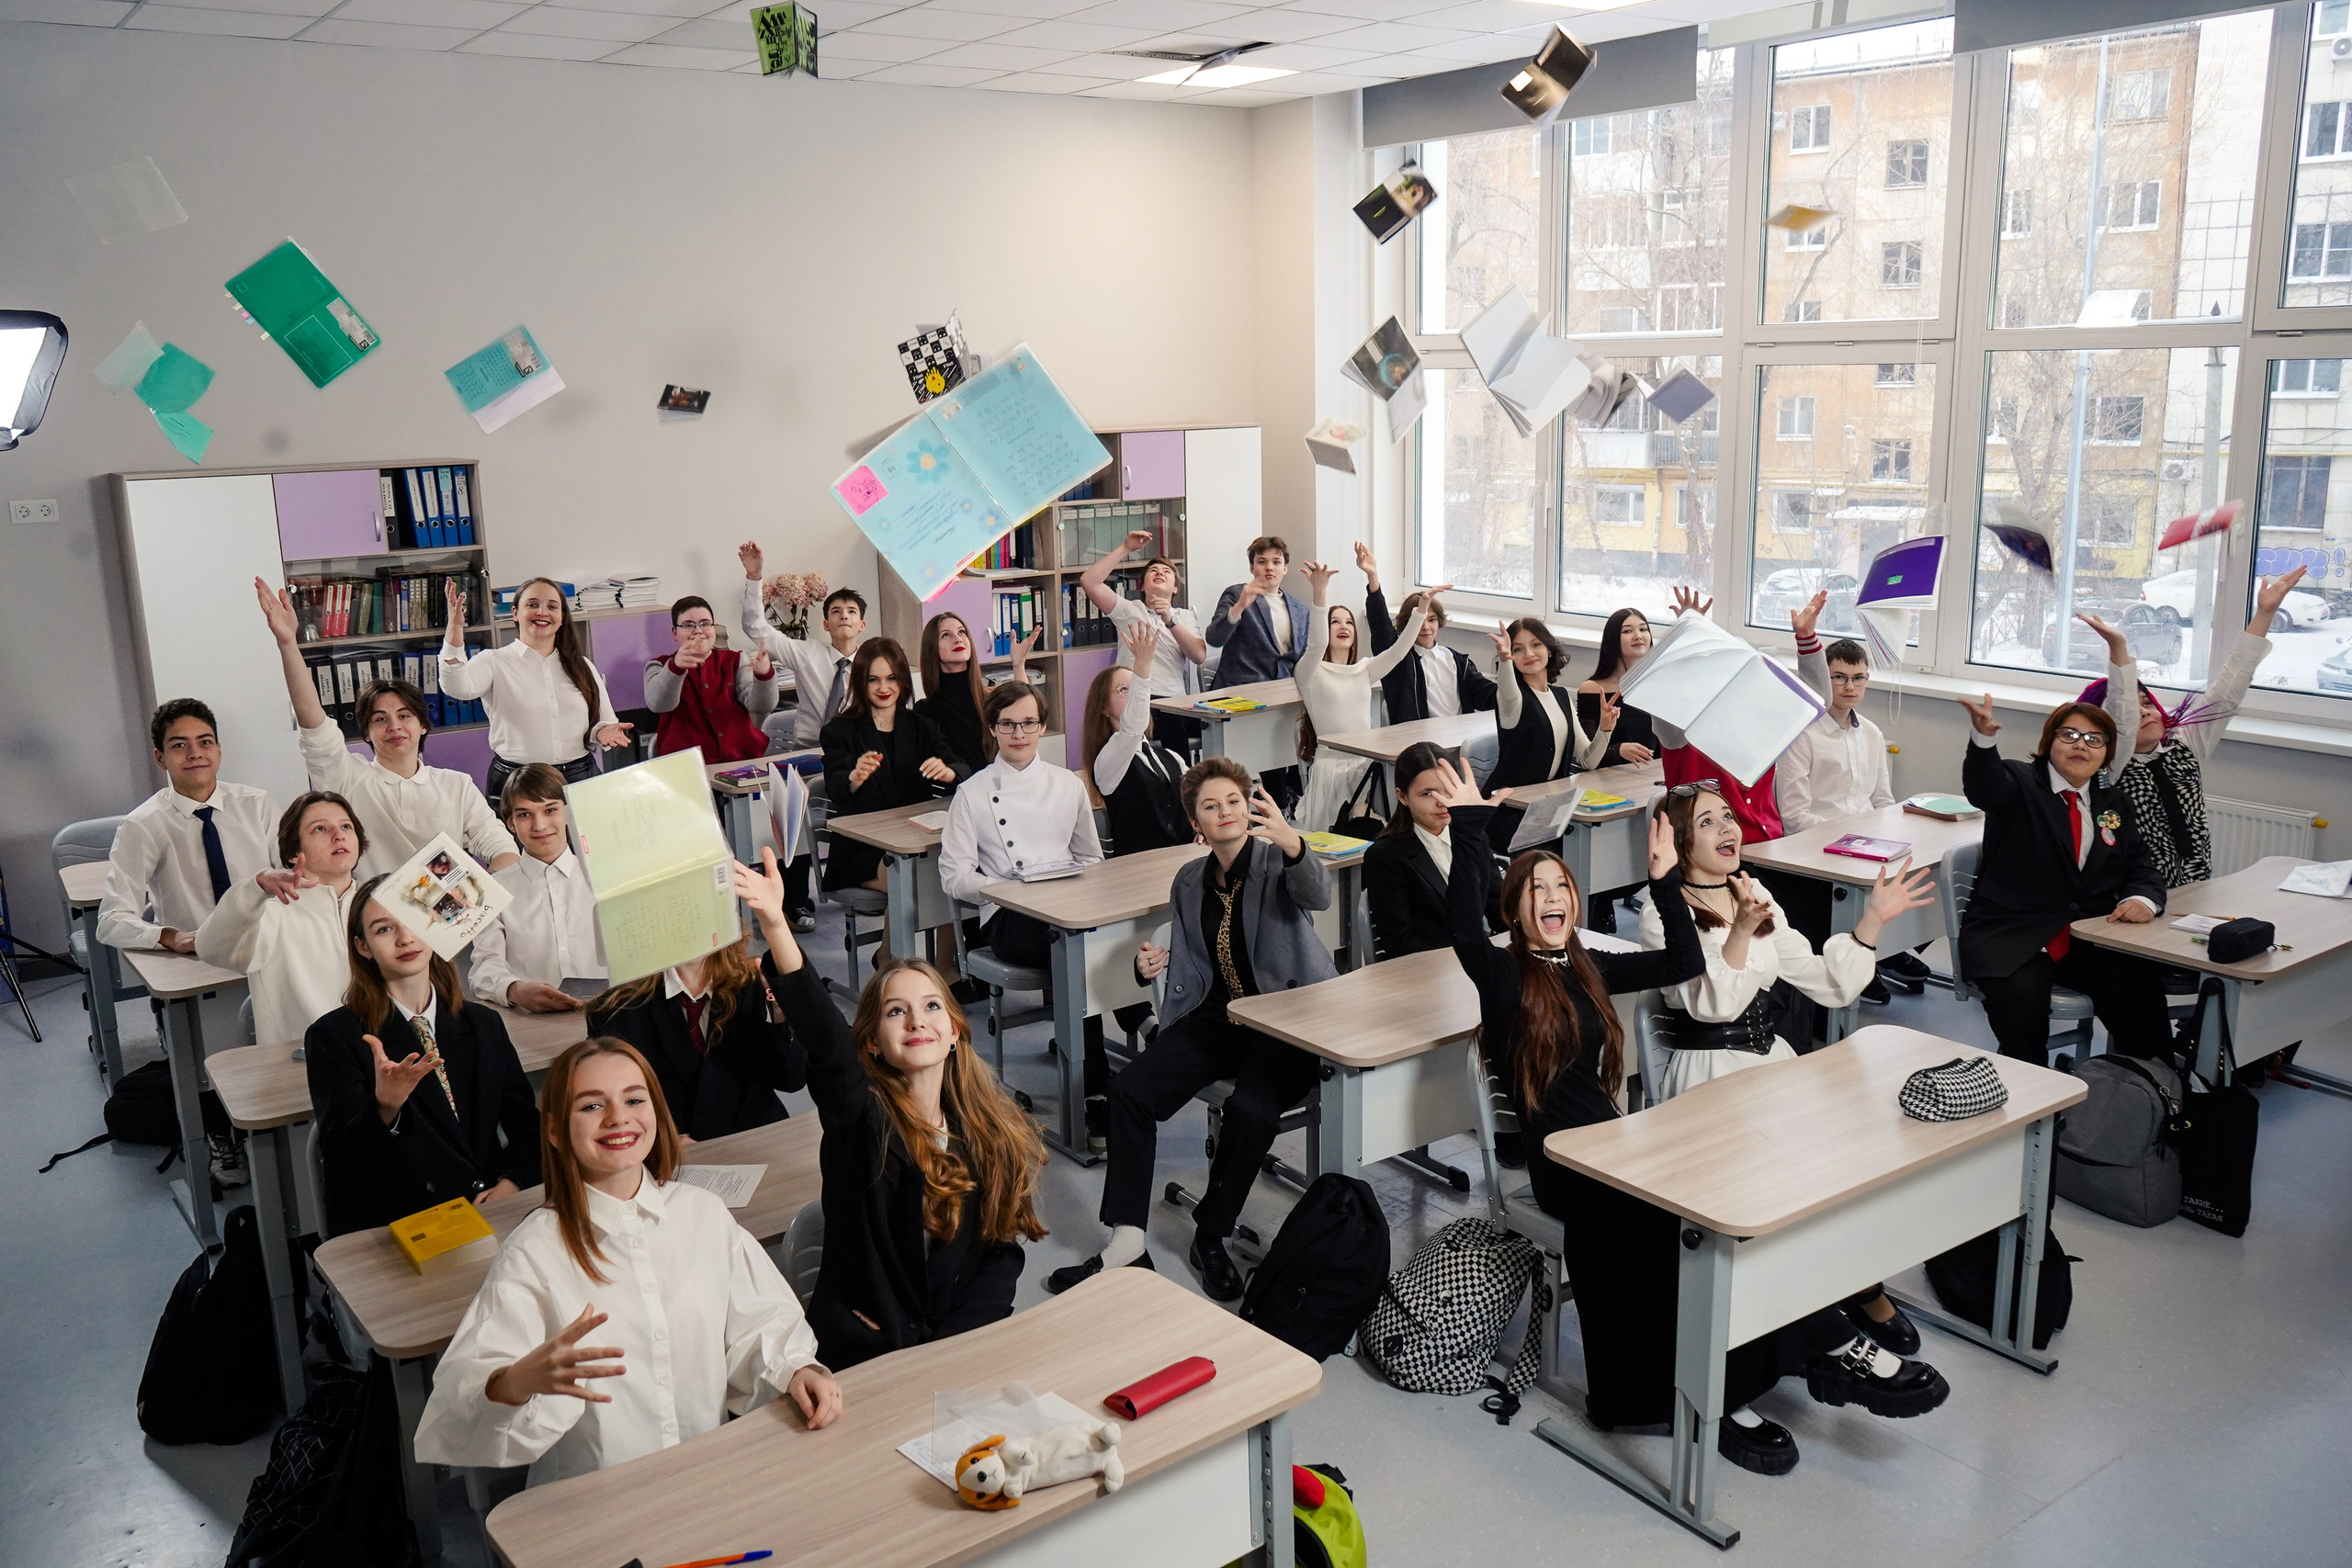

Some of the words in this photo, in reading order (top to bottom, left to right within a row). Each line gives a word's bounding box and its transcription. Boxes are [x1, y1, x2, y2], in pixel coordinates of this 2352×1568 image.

[458, 485, 464, 495] 8
[460, 904, 494, 938] biscotto
[2184, 1196, 2224, 1212] ТАКИЕ...
[2197, 1208, 2223, 1222] ТАКАЯ
